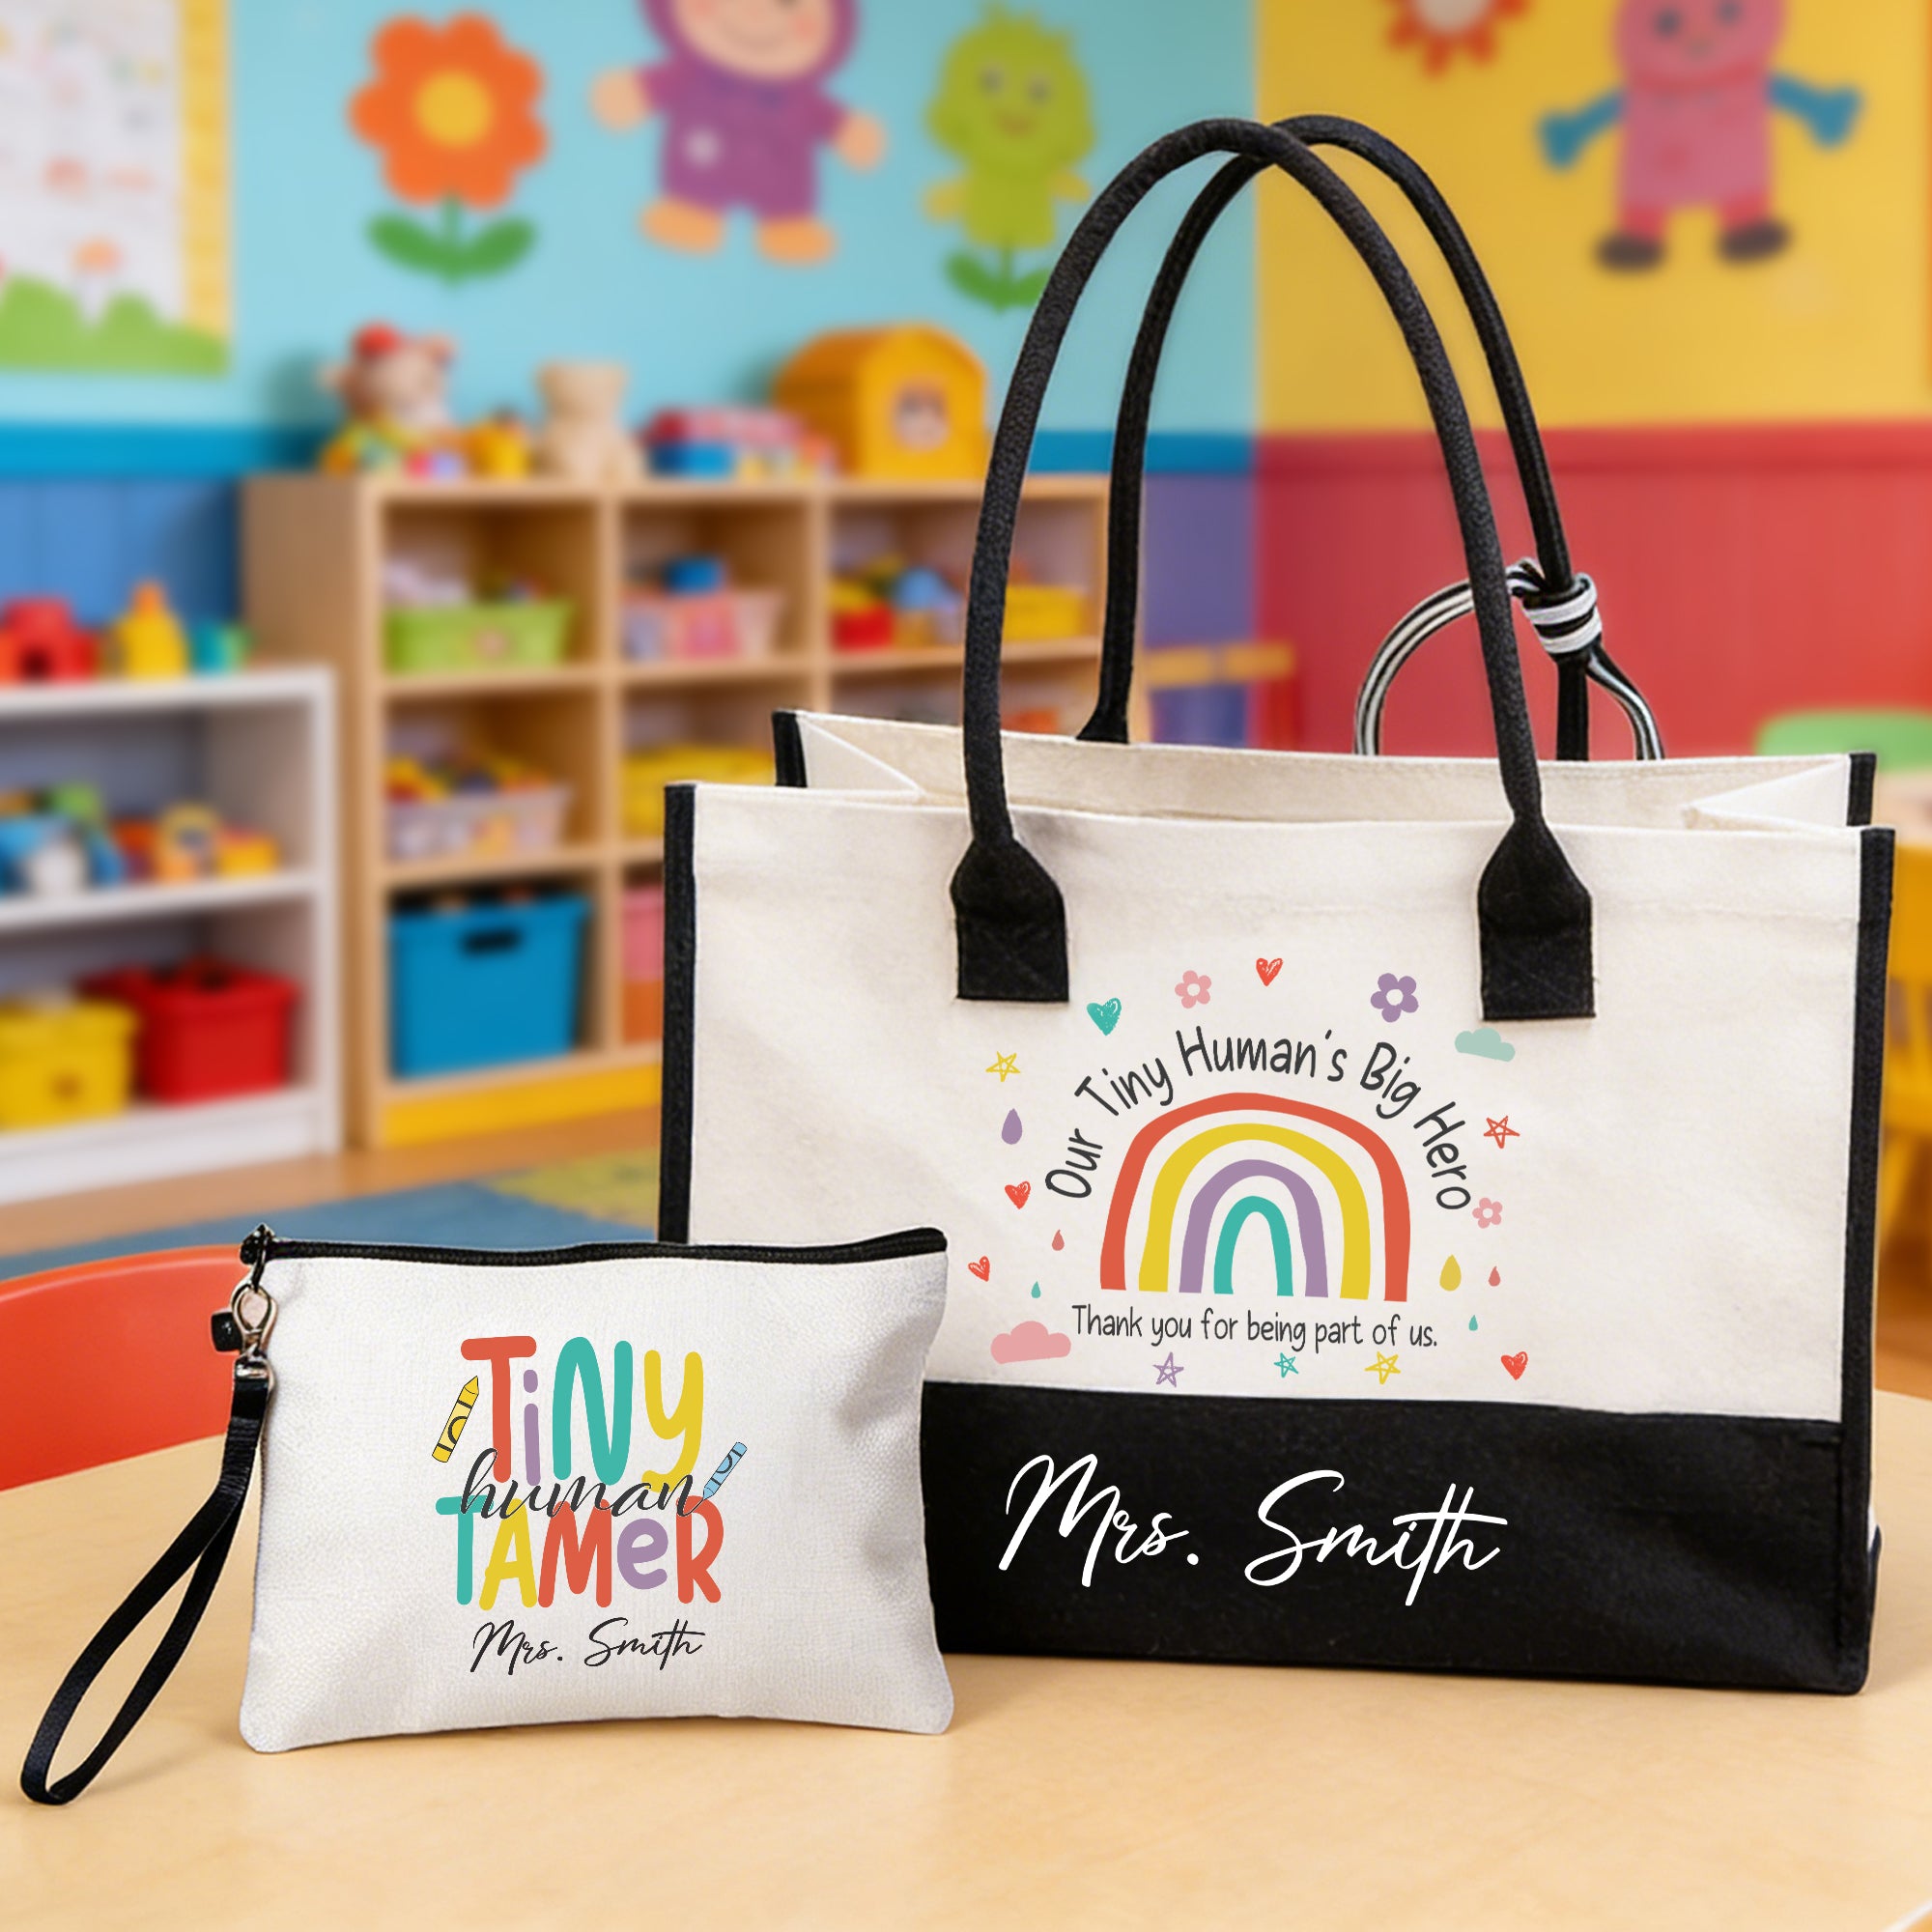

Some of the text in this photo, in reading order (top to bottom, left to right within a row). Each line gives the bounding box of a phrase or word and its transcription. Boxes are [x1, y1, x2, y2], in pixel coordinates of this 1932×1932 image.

[1044, 1025, 1471, 1210] Our Tiny Human's Big Hero
[1071, 1303, 1438, 1354] Thank you for being part of us.
[460, 1447, 703, 1519] human
[998, 1453, 1508, 1606] Mrs. Smith
[469, 1616, 706, 1676] Mrs. Smith
